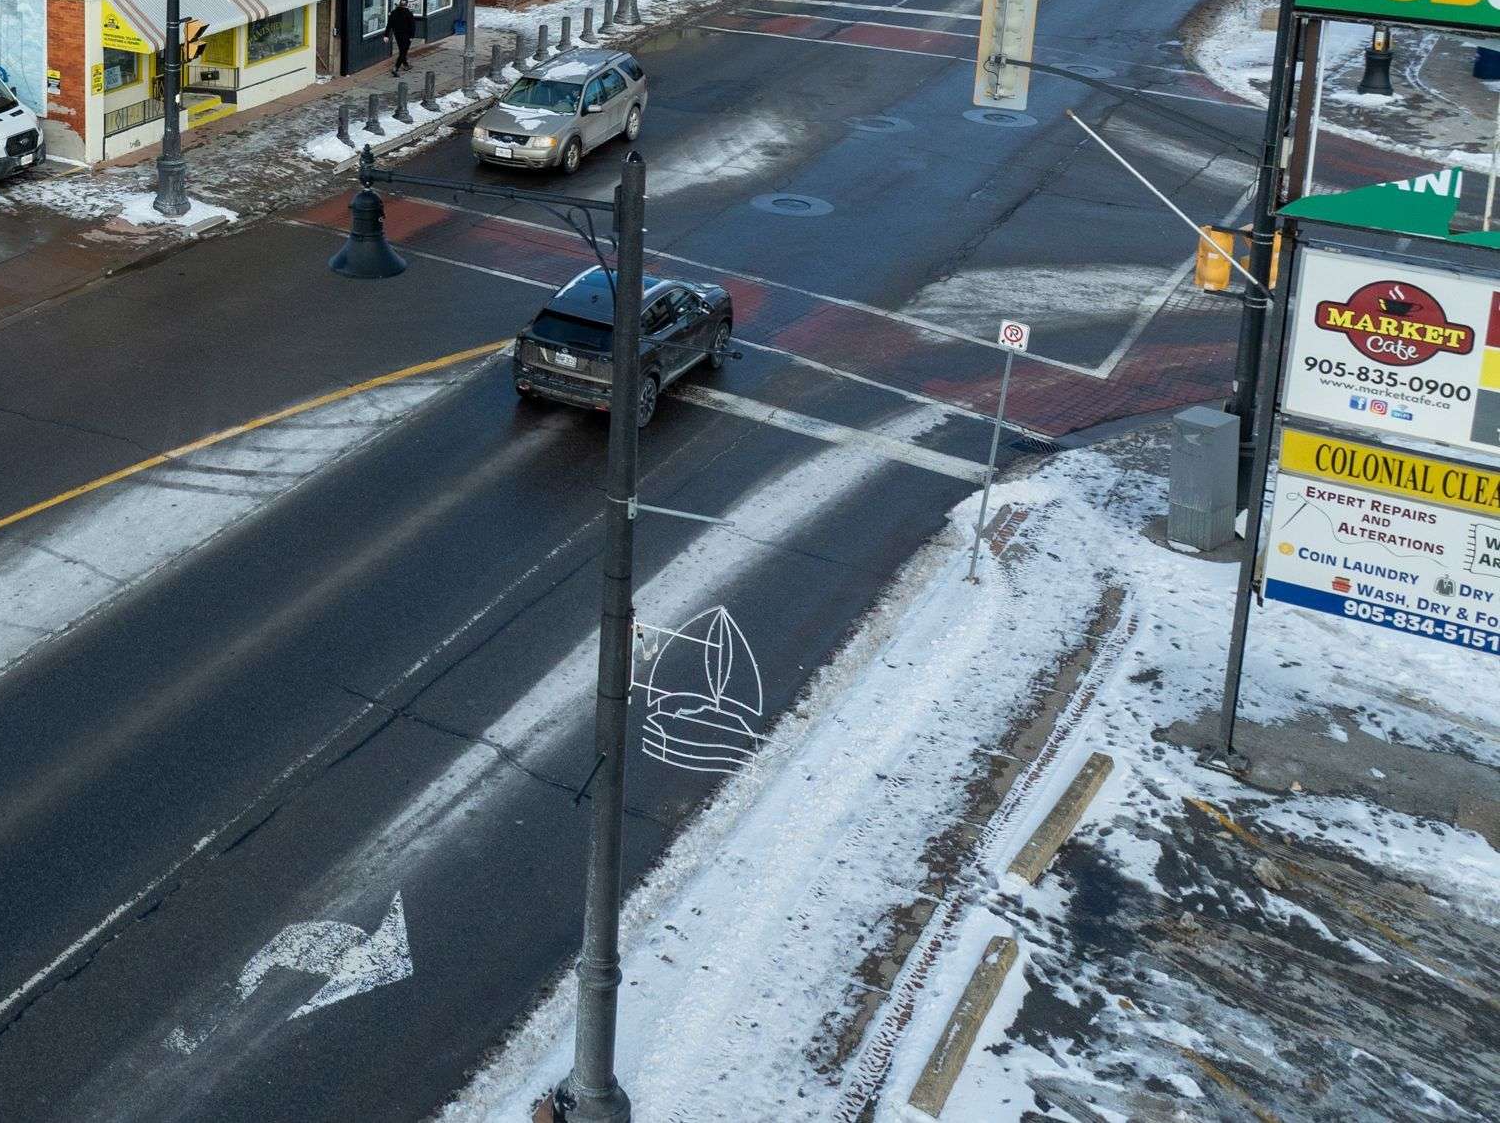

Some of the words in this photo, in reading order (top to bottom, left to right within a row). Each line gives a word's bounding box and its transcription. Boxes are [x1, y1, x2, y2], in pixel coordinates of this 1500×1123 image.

[1326, 307, 1465, 348] MARKET
[1366, 335, 1419, 361] Cafe
[1304, 356, 1471, 402] 905-835-0900
[1320, 377, 1451, 410] www.marketcafe.ca
[1315, 443, 1434, 494] COLONIAL
[1306, 486, 1365, 508] EXPERT
[1370, 499, 1437, 525] REPAIRS
[1361, 514, 1391, 527] AND
[1338, 522, 1445, 555] ALTERATIONS
[1298, 547, 1337, 566] COIN
[1343, 557, 1420, 585] LAUNDRY
[1417, 597, 1451, 616] DRY
[1456, 607, 1469, 621] &
[1459, 584, 1494, 603] DRY
[1343, 599, 1500, 652] 905-834-5151
